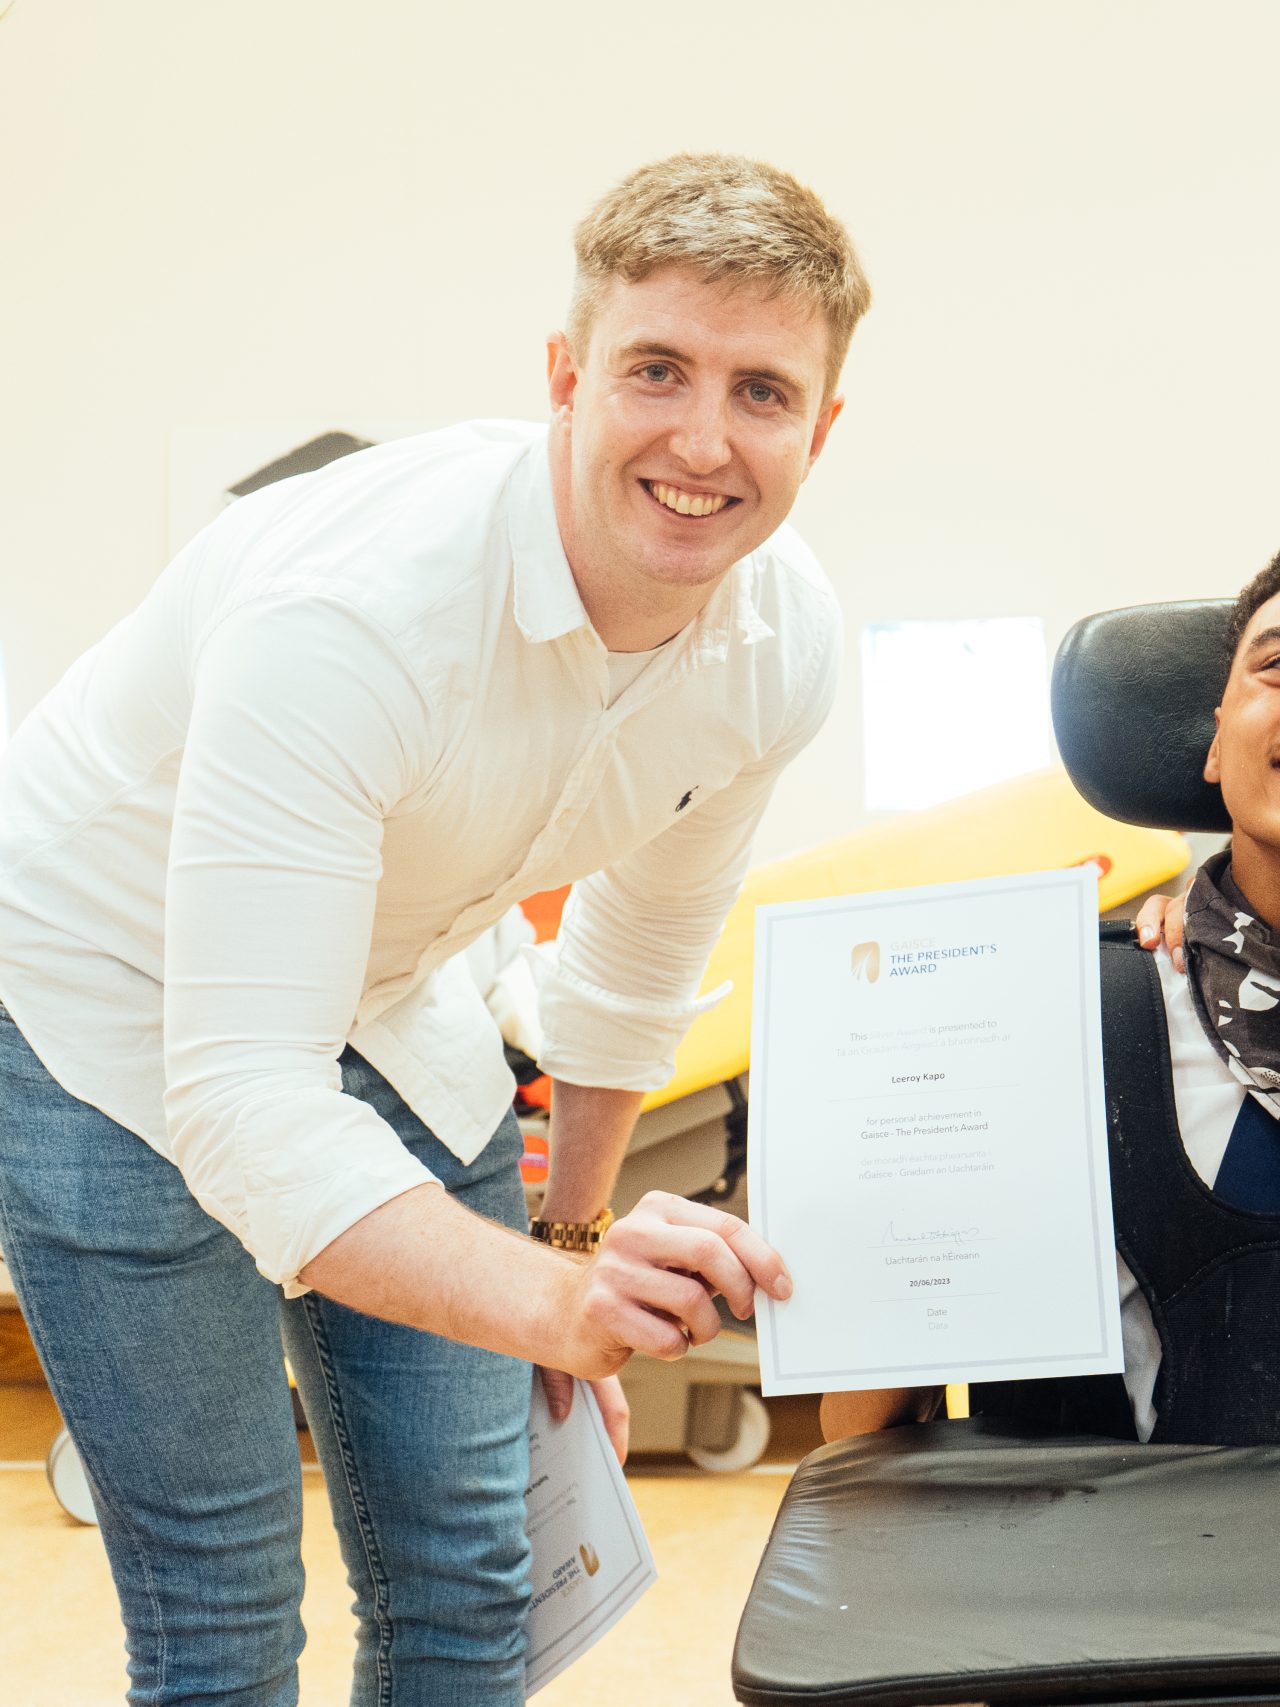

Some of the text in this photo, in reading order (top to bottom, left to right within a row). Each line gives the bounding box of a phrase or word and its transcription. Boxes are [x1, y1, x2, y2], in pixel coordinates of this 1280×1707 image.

[890, 944, 997, 964] THE PRESIDENT'S
[890, 964, 937, 977] AWARD
[850, 1032, 868, 1042] This
[928, 1025, 936, 1034] is
[938, 1020, 986, 1035] presented
[987, 1020, 998, 1028] to
[891, 1072, 946, 1084] Leeroy Kapo
[866, 1109, 982, 1126] for personal achievement in
[860, 1130, 889, 1140] Gaisce
[896, 1128, 912, 1136] The
[913, 1124, 959, 1136] President's
[960, 1122, 988, 1132] Award
[898, 1167, 934, 1178] Gradam
[936, 1166, 947, 1174] an
[884, 1254, 930, 1266] Uachtarán
[930, 1254, 941, 1262] na
[909, 1278, 951, 1288] 20/06/2023
[927, 1308, 949, 1317] Date
